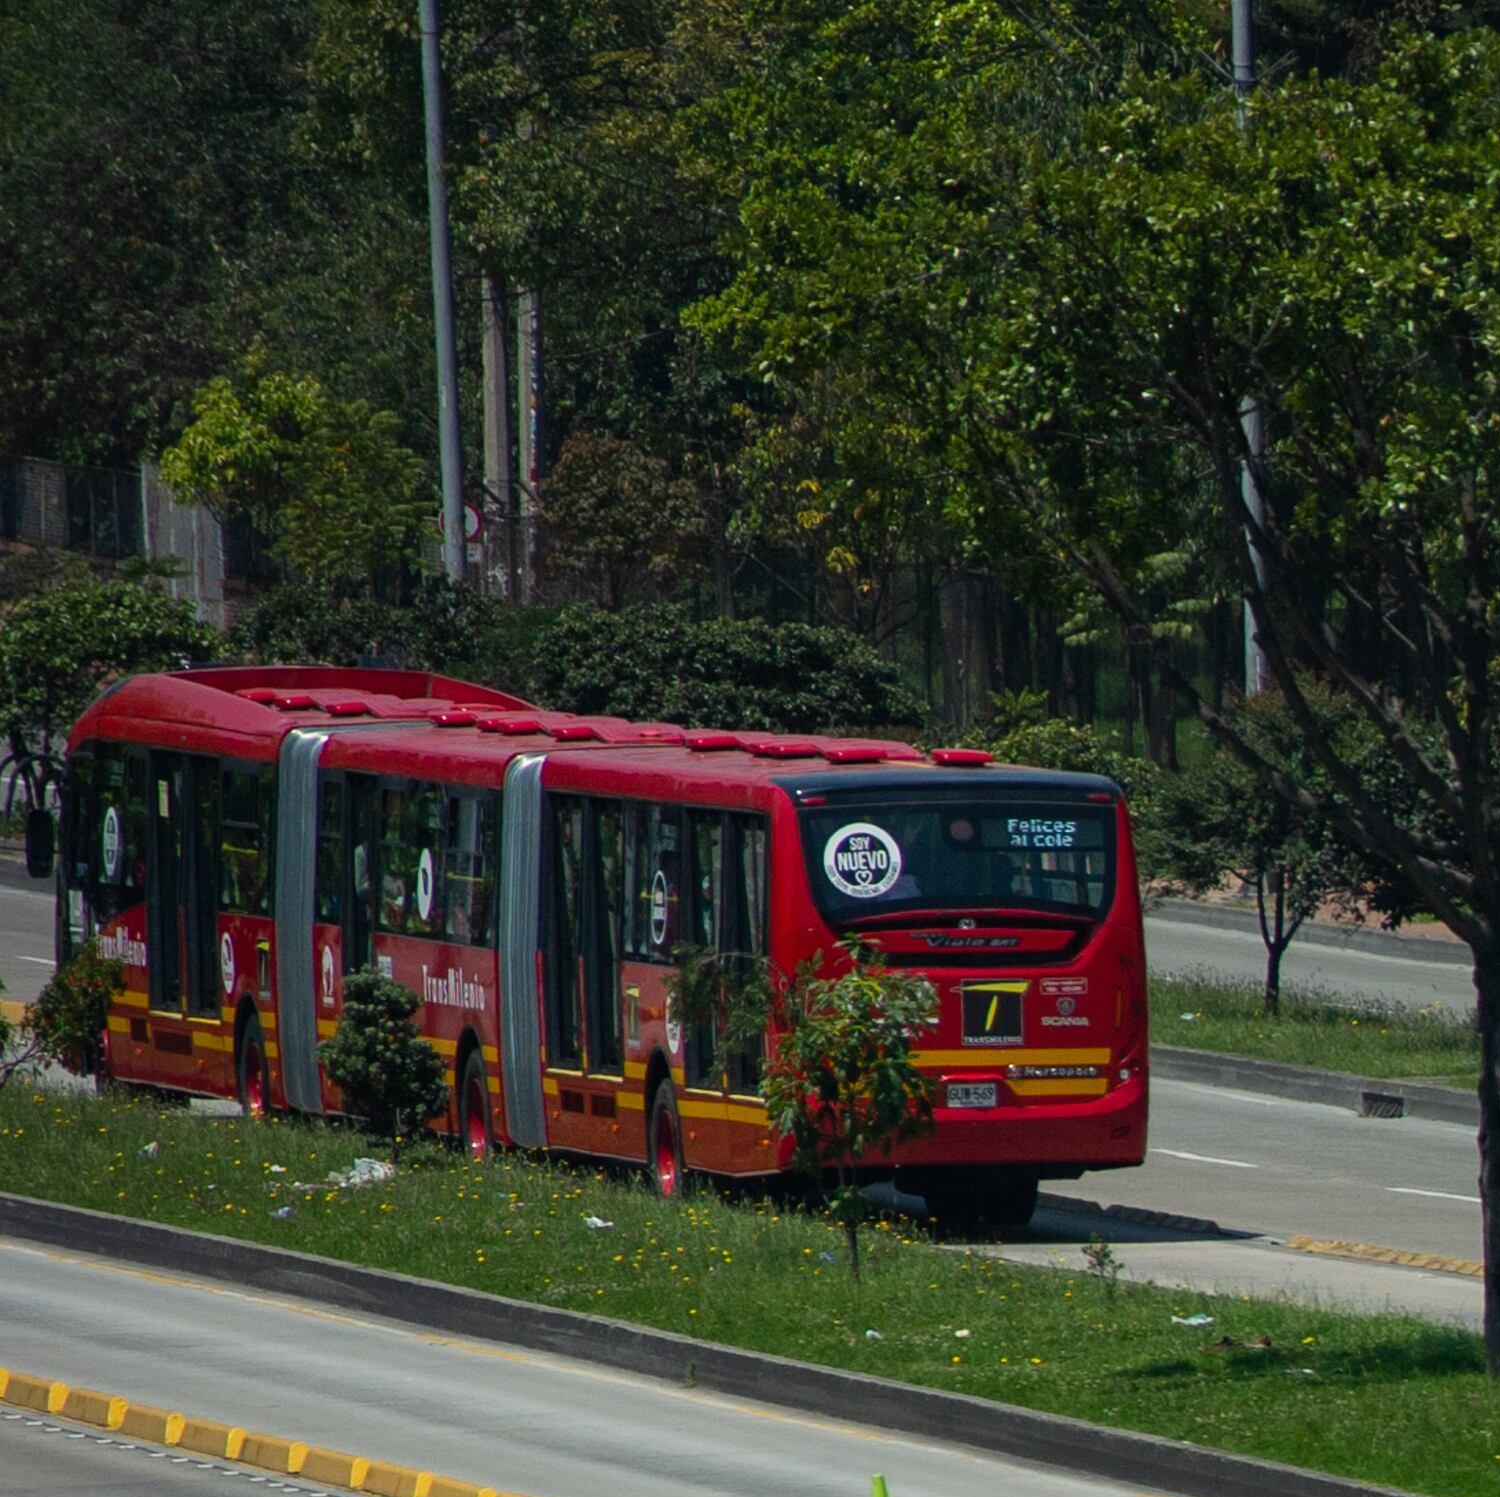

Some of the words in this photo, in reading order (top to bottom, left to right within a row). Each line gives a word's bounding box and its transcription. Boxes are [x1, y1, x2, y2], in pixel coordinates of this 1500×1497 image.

[1007, 819, 1077, 833] Felices
[849, 837, 869, 850] SOY
[1033, 833, 1073, 847] cole
[837, 850, 887, 871] NUEVO
[422, 964, 485, 1011] TransMilenio
[1041, 1016, 1090, 1026] SCANIA
